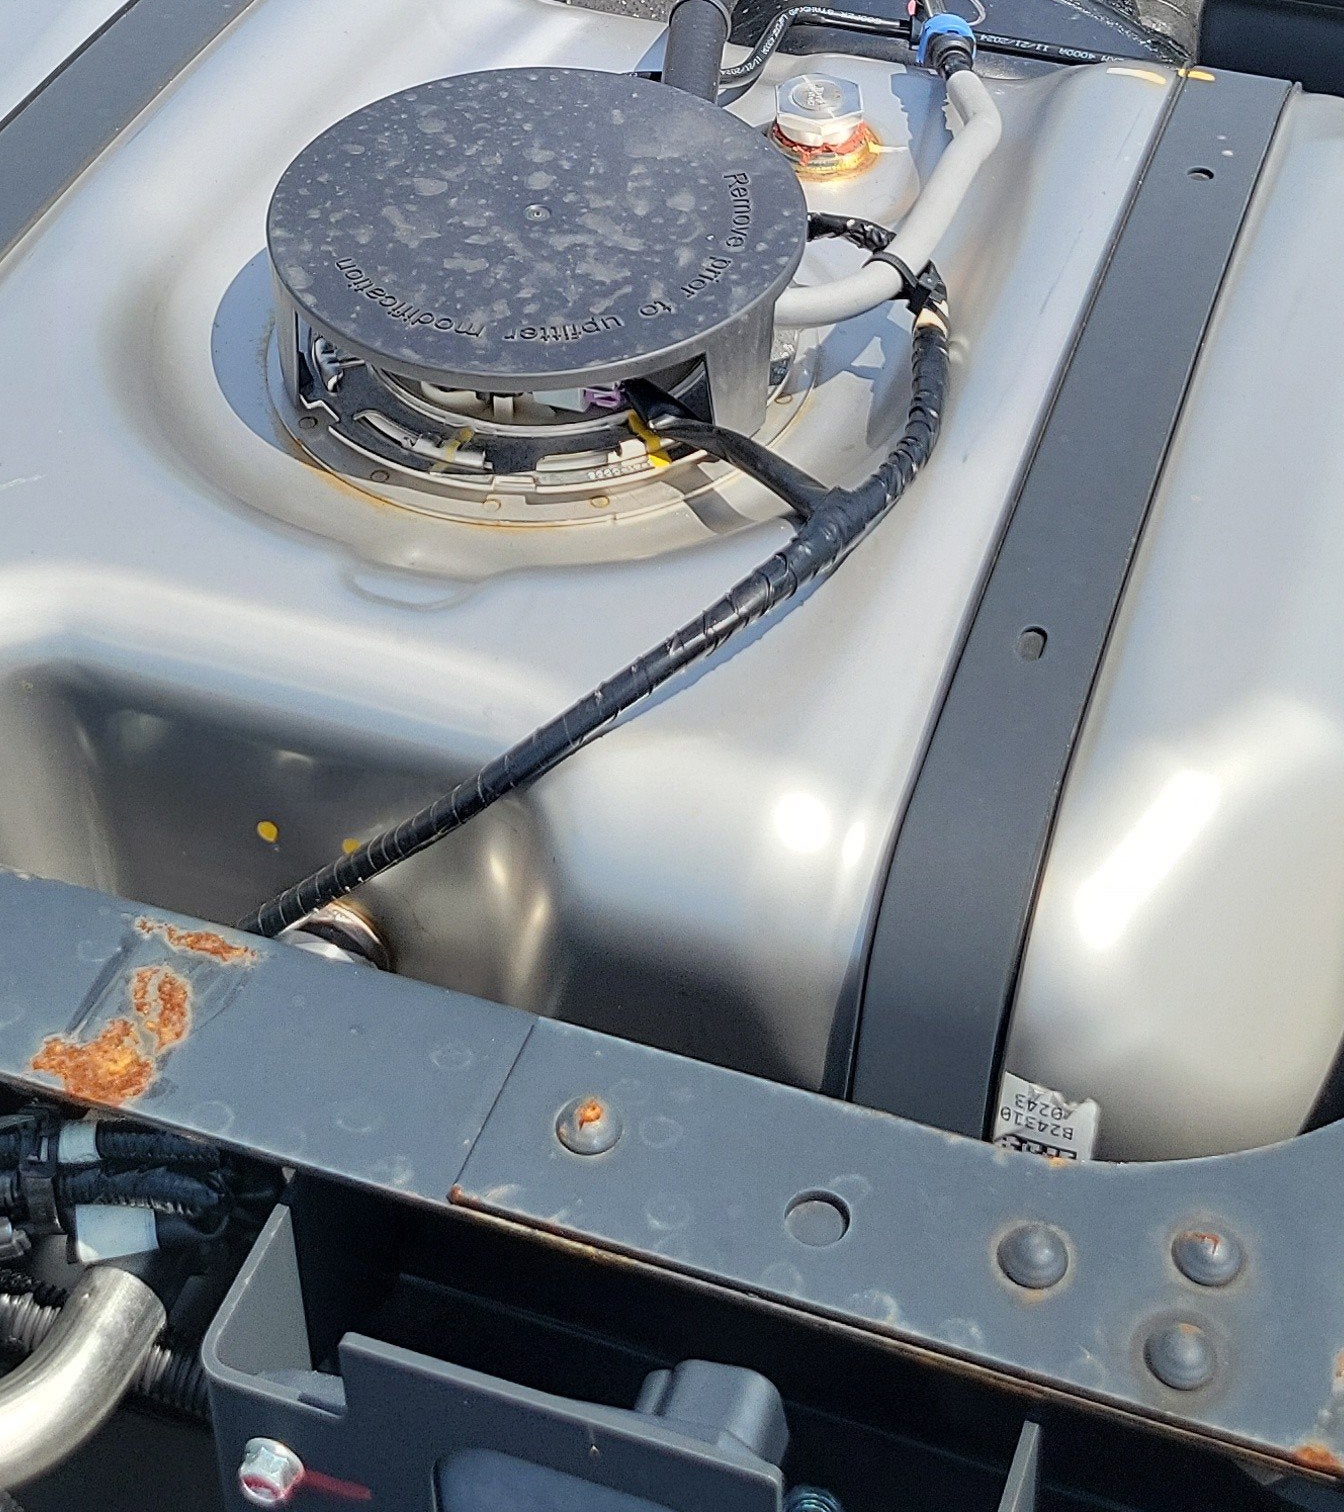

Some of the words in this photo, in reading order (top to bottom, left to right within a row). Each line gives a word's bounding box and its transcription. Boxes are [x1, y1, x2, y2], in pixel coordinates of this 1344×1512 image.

[723, 171, 752, 249] Remove
[679, 255, 732, 299] prior
[334, 256, 486, 339] modification
[638, 298, 672, 320] to
[504, 315, 624, 343] upfitter
[1000, 1106, 1074, 1141] B24310
